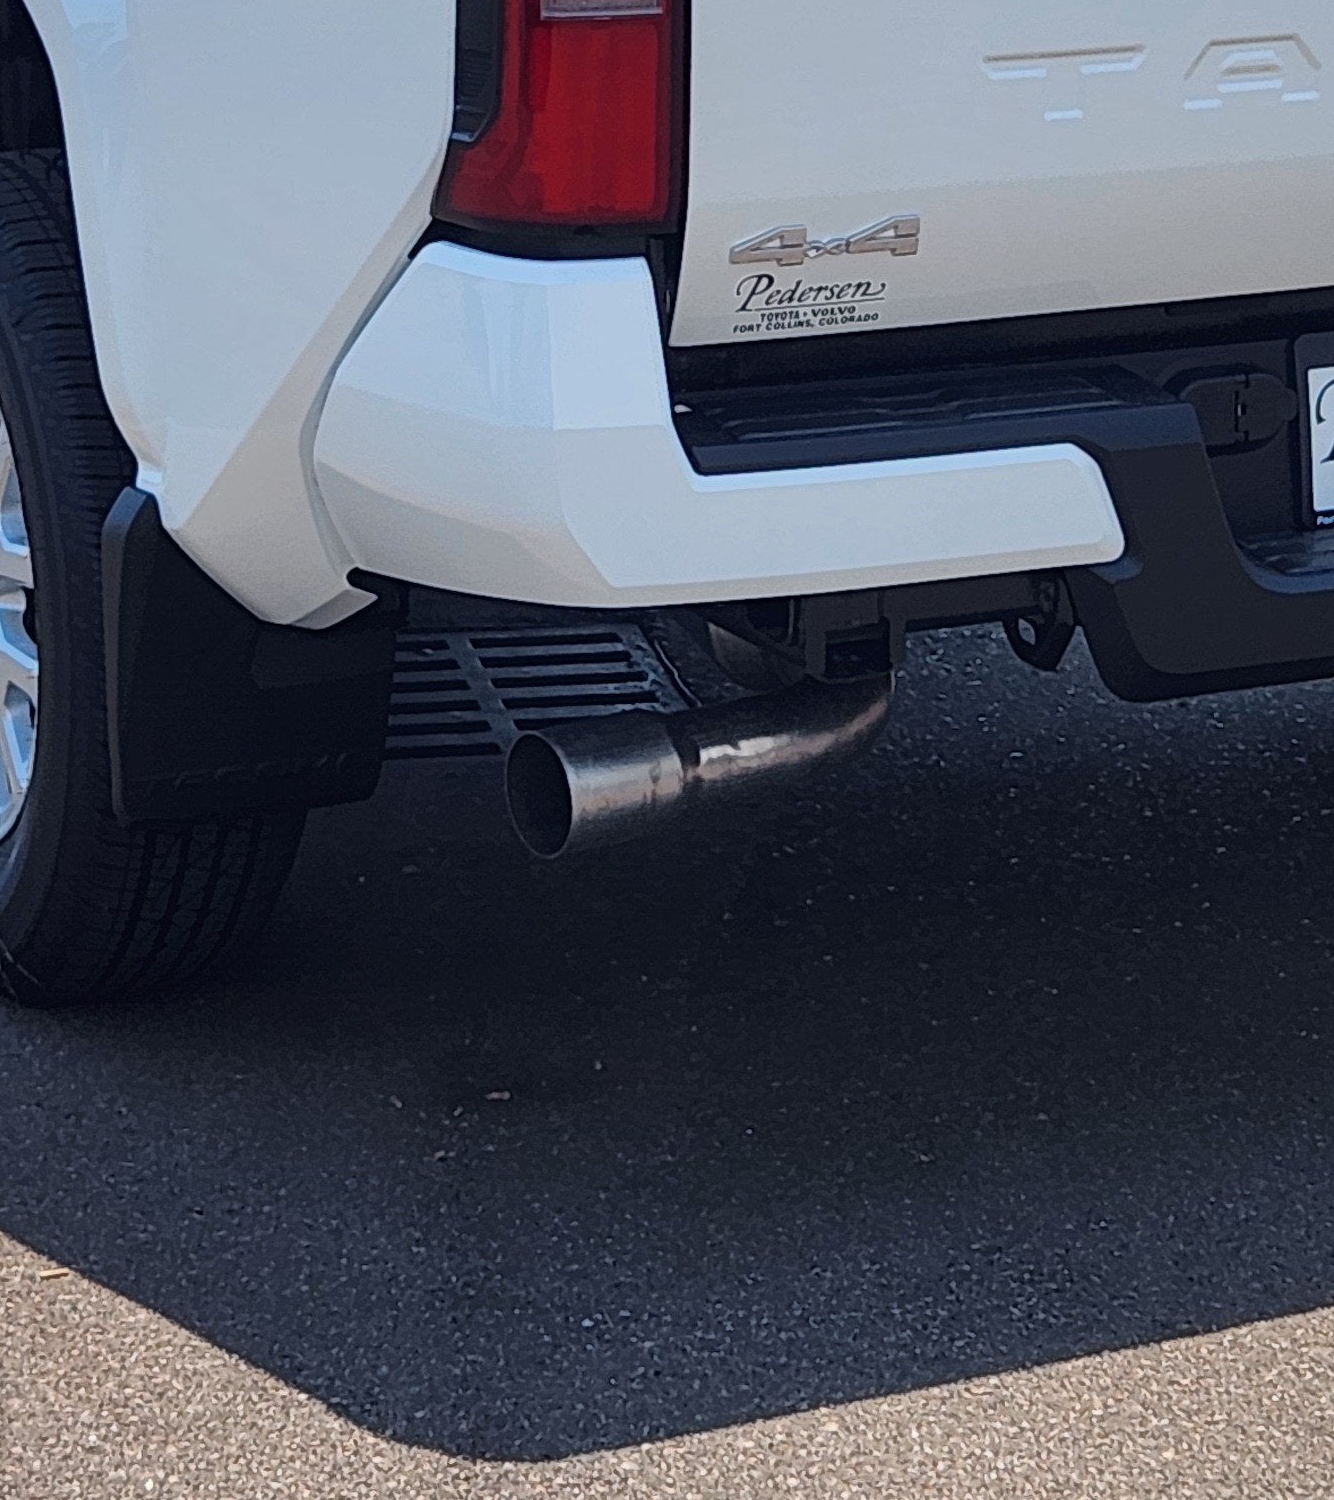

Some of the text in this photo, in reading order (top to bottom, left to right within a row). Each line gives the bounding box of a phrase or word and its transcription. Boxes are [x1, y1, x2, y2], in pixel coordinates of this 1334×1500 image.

[735, 274, 886, 312] Pedersen
[733, 324, 762, 334] FORT
[818, 312, 879, 327] COLORADO
[760, 305, 857, 323] TOYOTA VOLVO
